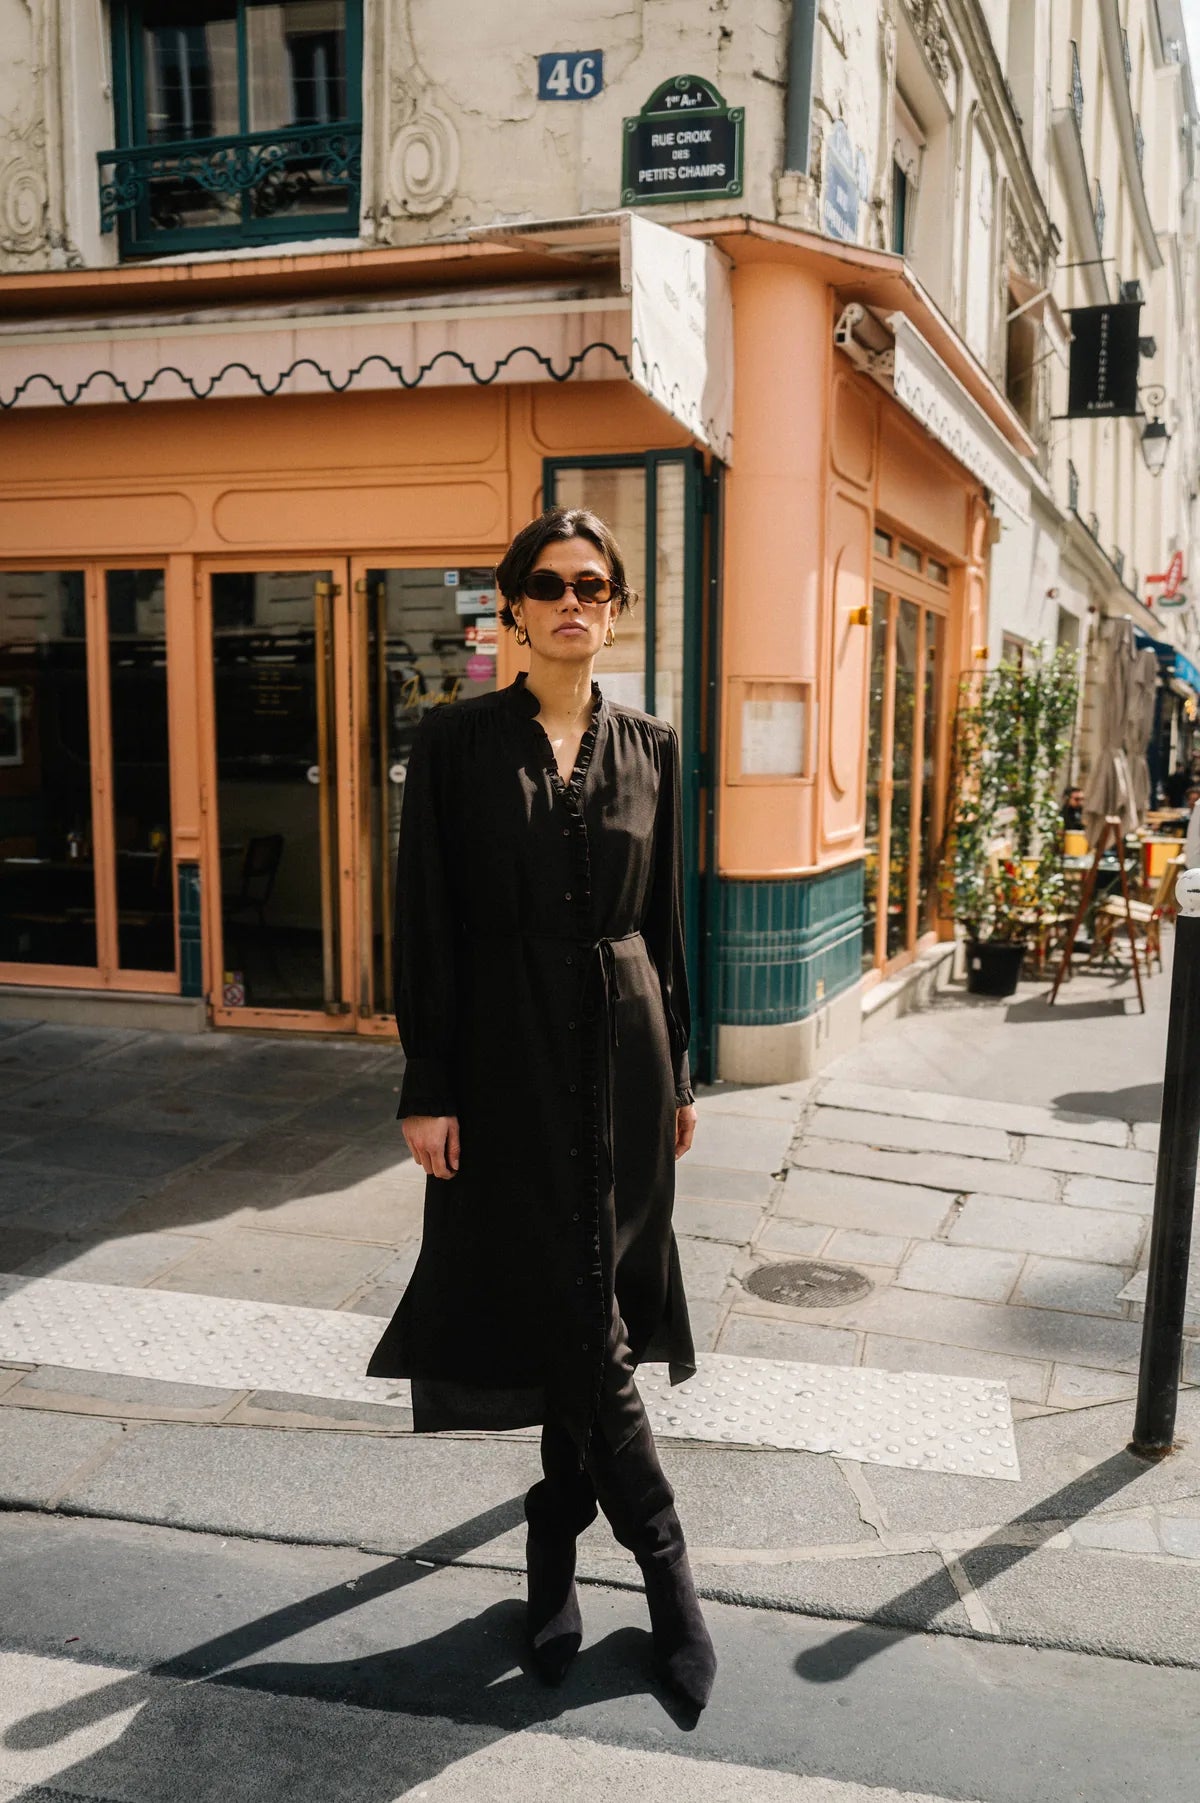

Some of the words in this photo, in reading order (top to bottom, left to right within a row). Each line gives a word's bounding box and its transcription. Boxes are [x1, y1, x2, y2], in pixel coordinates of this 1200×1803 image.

[546, 58, 595, 95] 46
[651, 133, 675, 146] RUE
[676, 129, 712, 144] CROIX
[672, 149, 690, 160] DES
[639, 167, 677, 182] PETITS
[678, 163, 726, 179] CHAMPS
